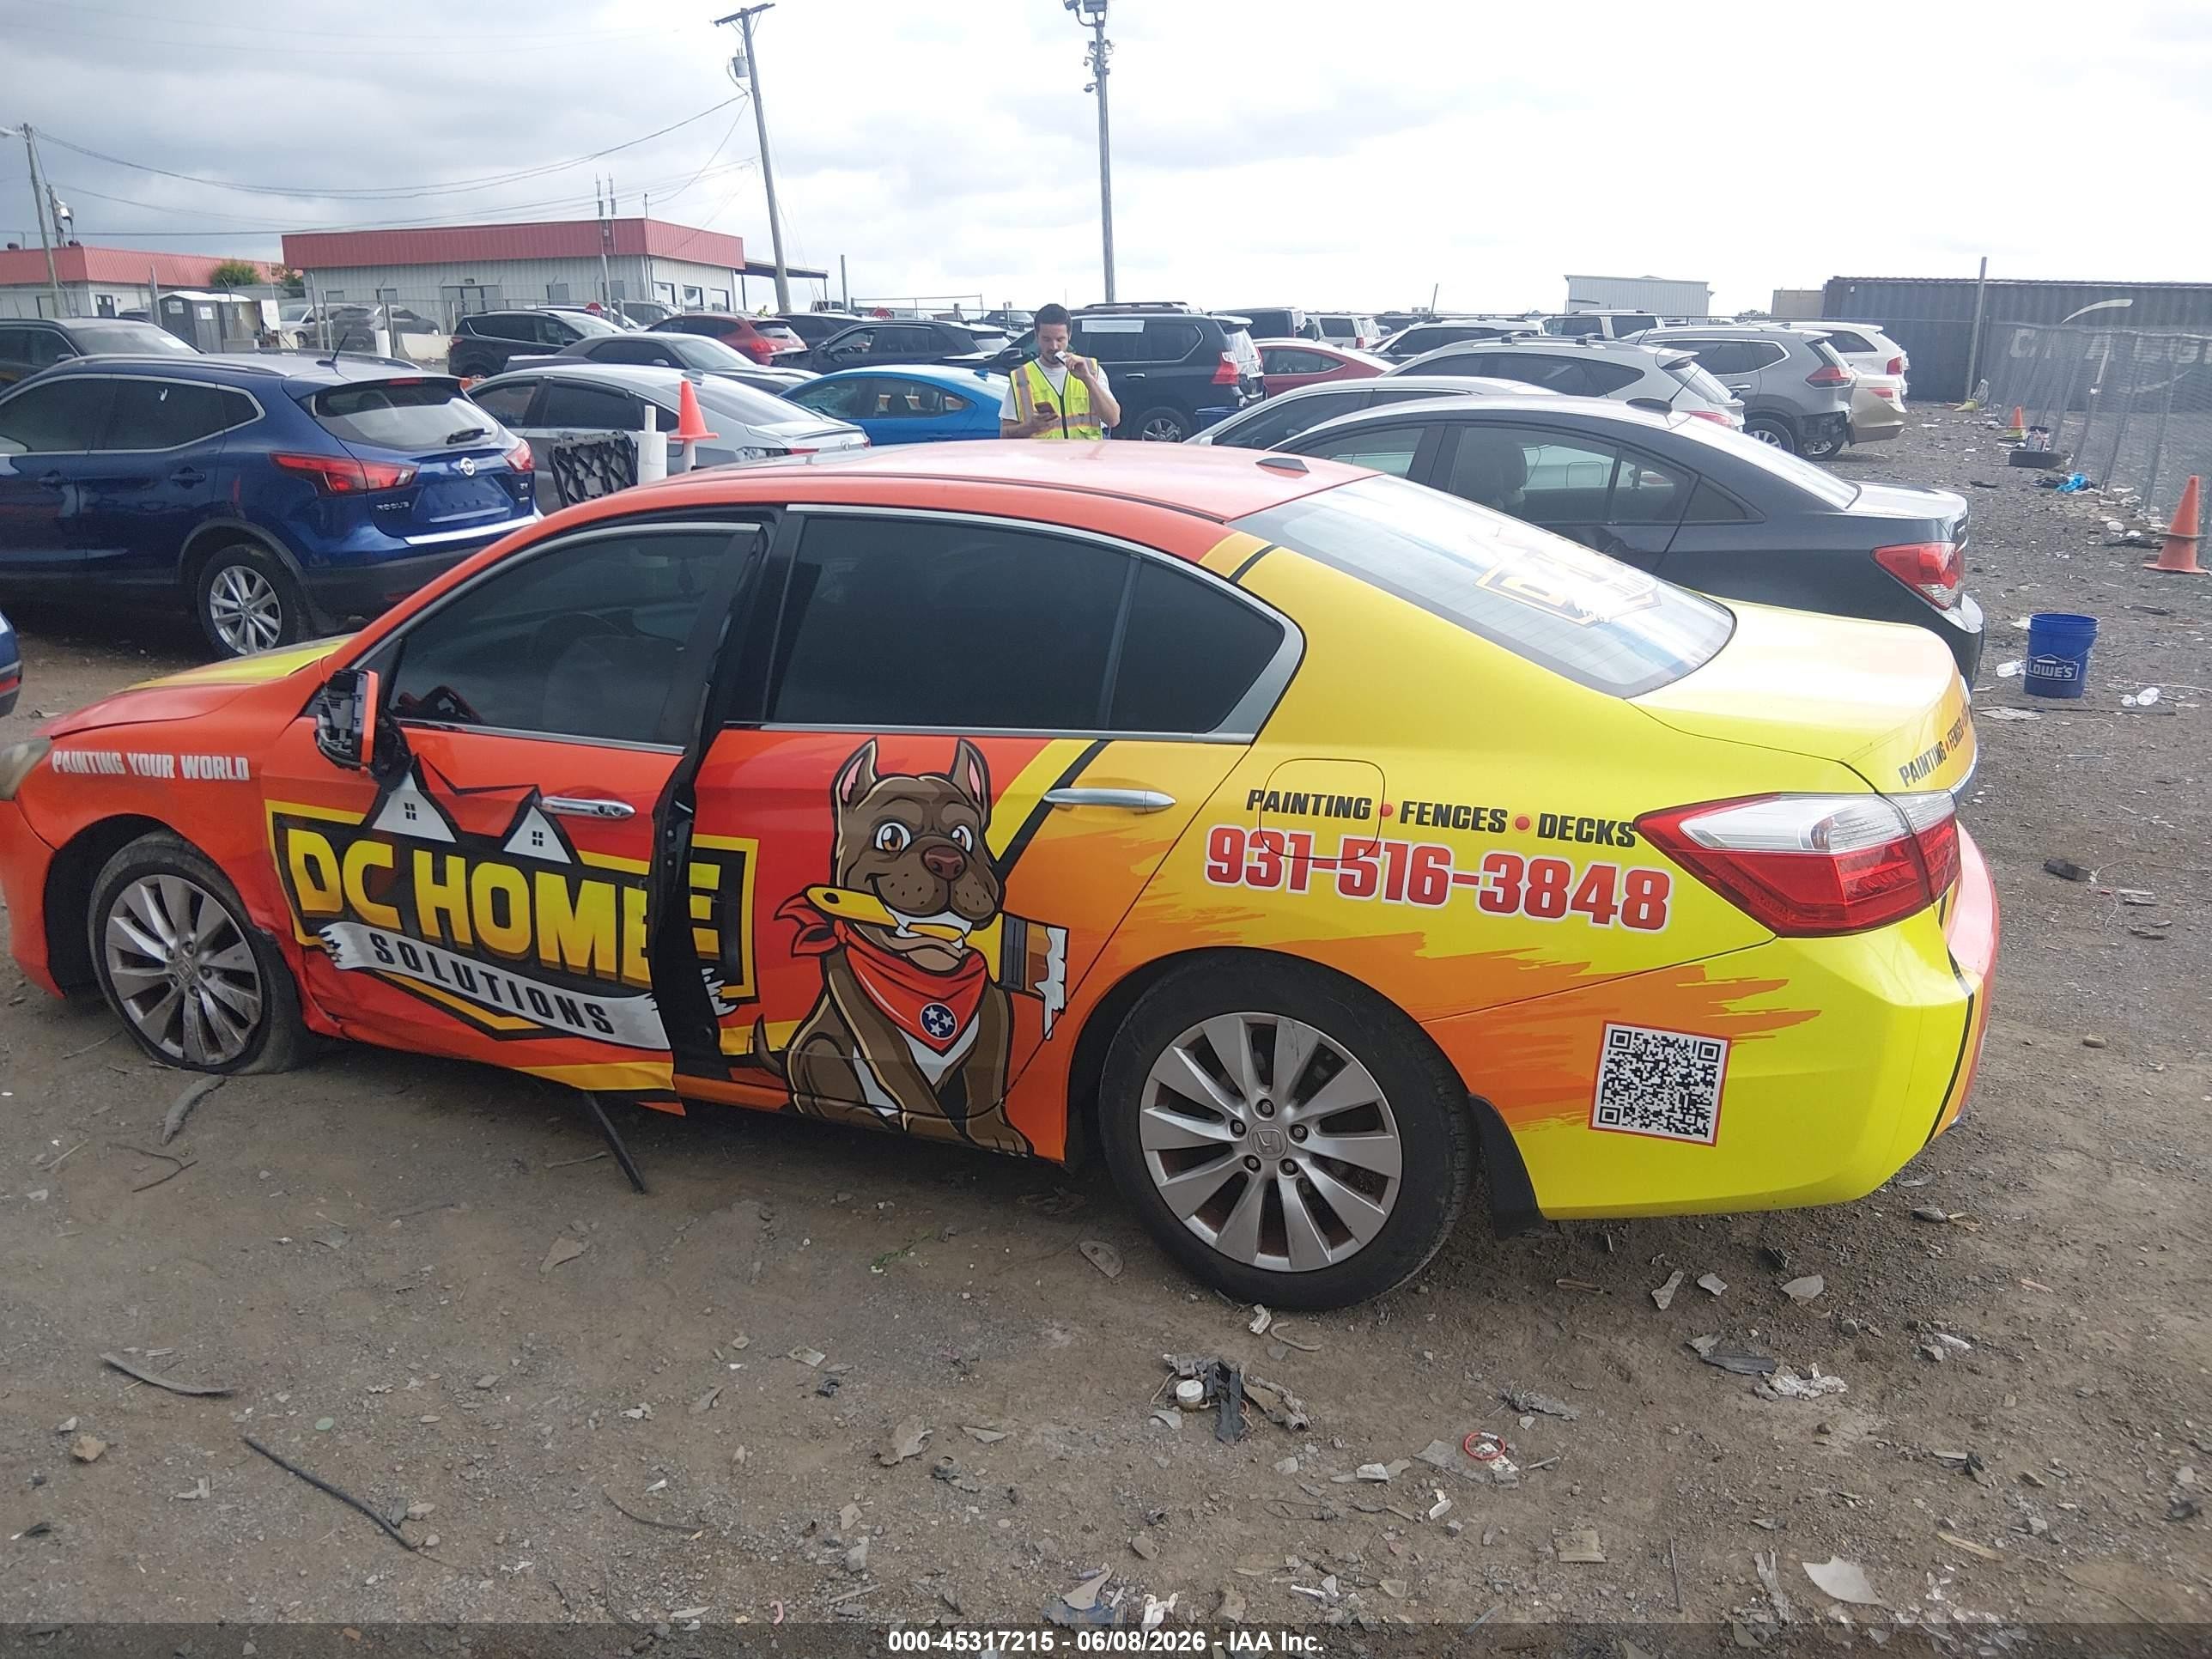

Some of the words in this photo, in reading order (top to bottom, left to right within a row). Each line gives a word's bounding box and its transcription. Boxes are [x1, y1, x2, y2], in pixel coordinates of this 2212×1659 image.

[2027, 659, 2073, 678] LOWE'S
[52, 750, 126, 775] PAINTING
[127, 752, 175, 778] YOUR
[180, 755, 250, 781] WORLD
[1898, 740, 1947, 787] PAINTING
[1245, 789, 1372, 819] PAINTING
[1399, 800, 1509, 833] FENCES
[1536, 812, 1637, 848] DECKS
[288, 829, 402, 931] DC
[412, 848, 720, 988] HOME
[1205, 825, 1674, 933] 931-516-3848
[368, 932, 614, 1035] SOLUTIONS
